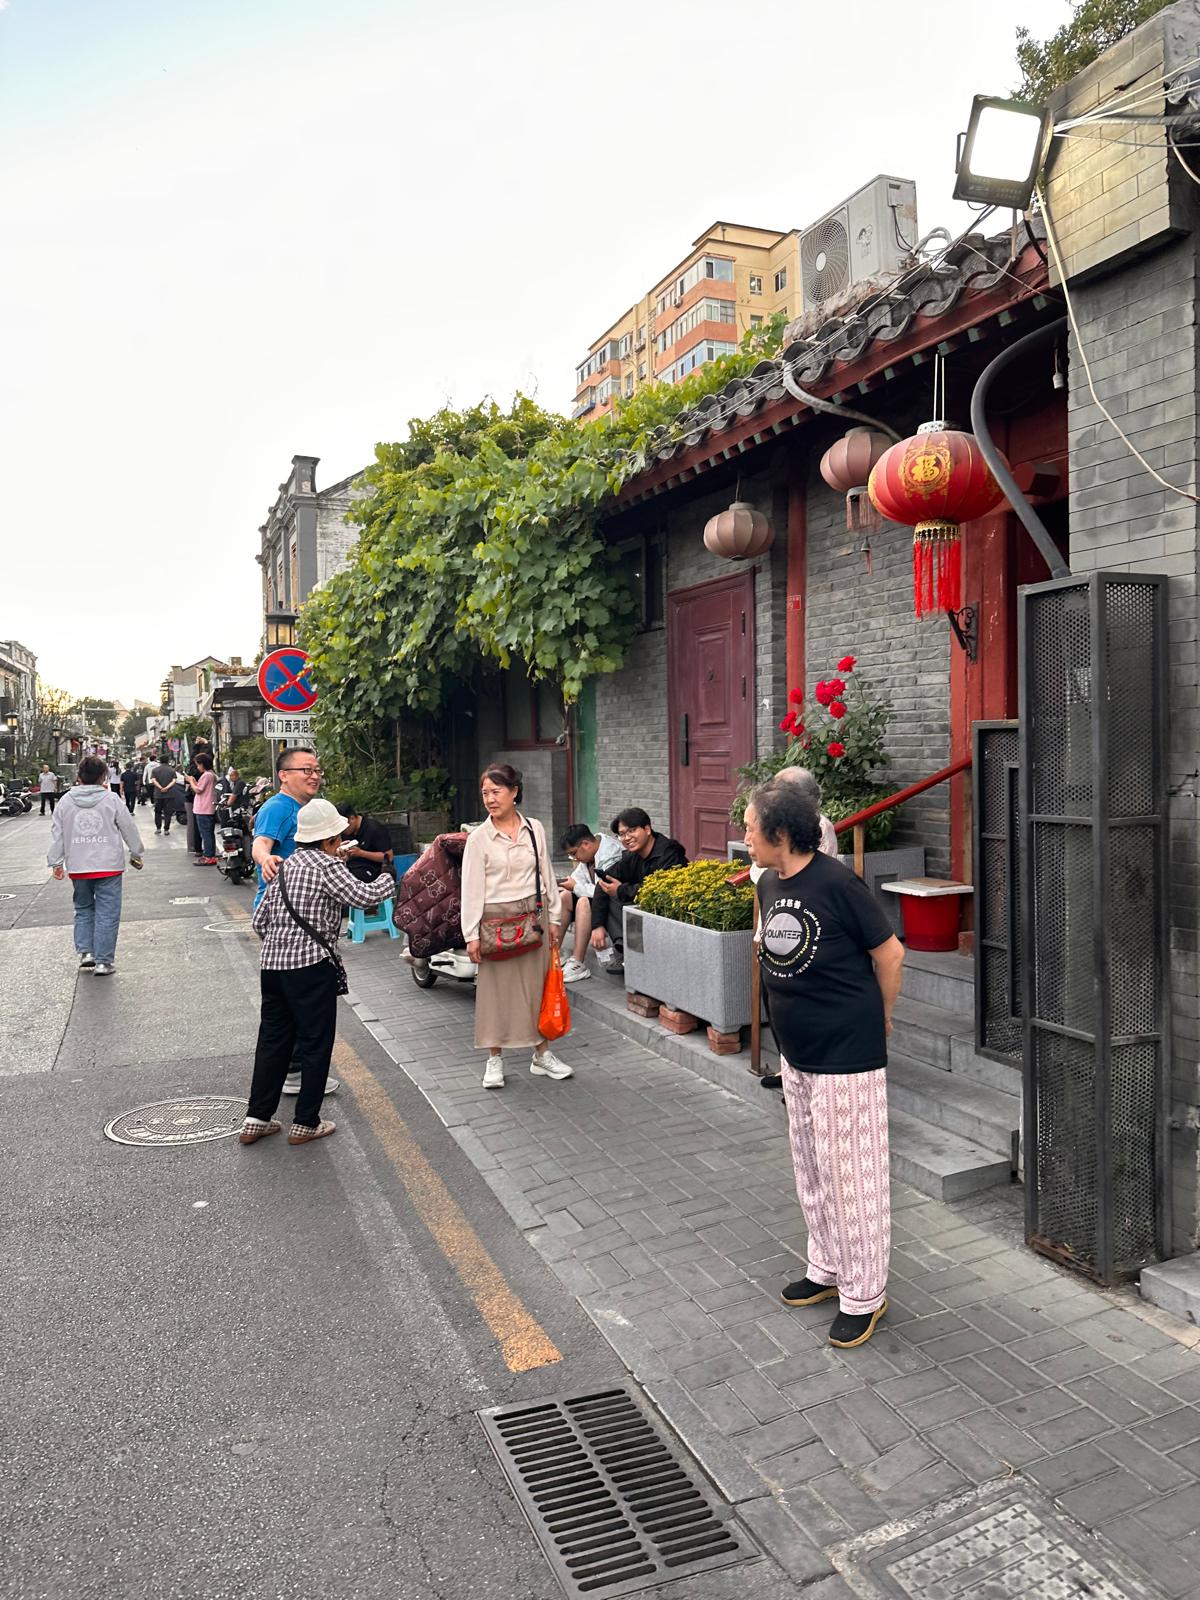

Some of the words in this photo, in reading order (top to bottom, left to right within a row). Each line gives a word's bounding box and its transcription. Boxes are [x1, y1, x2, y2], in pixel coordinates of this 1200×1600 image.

[911, 455, 940, 482] 福
[267, 719, 317, 734] 前门西河沿
